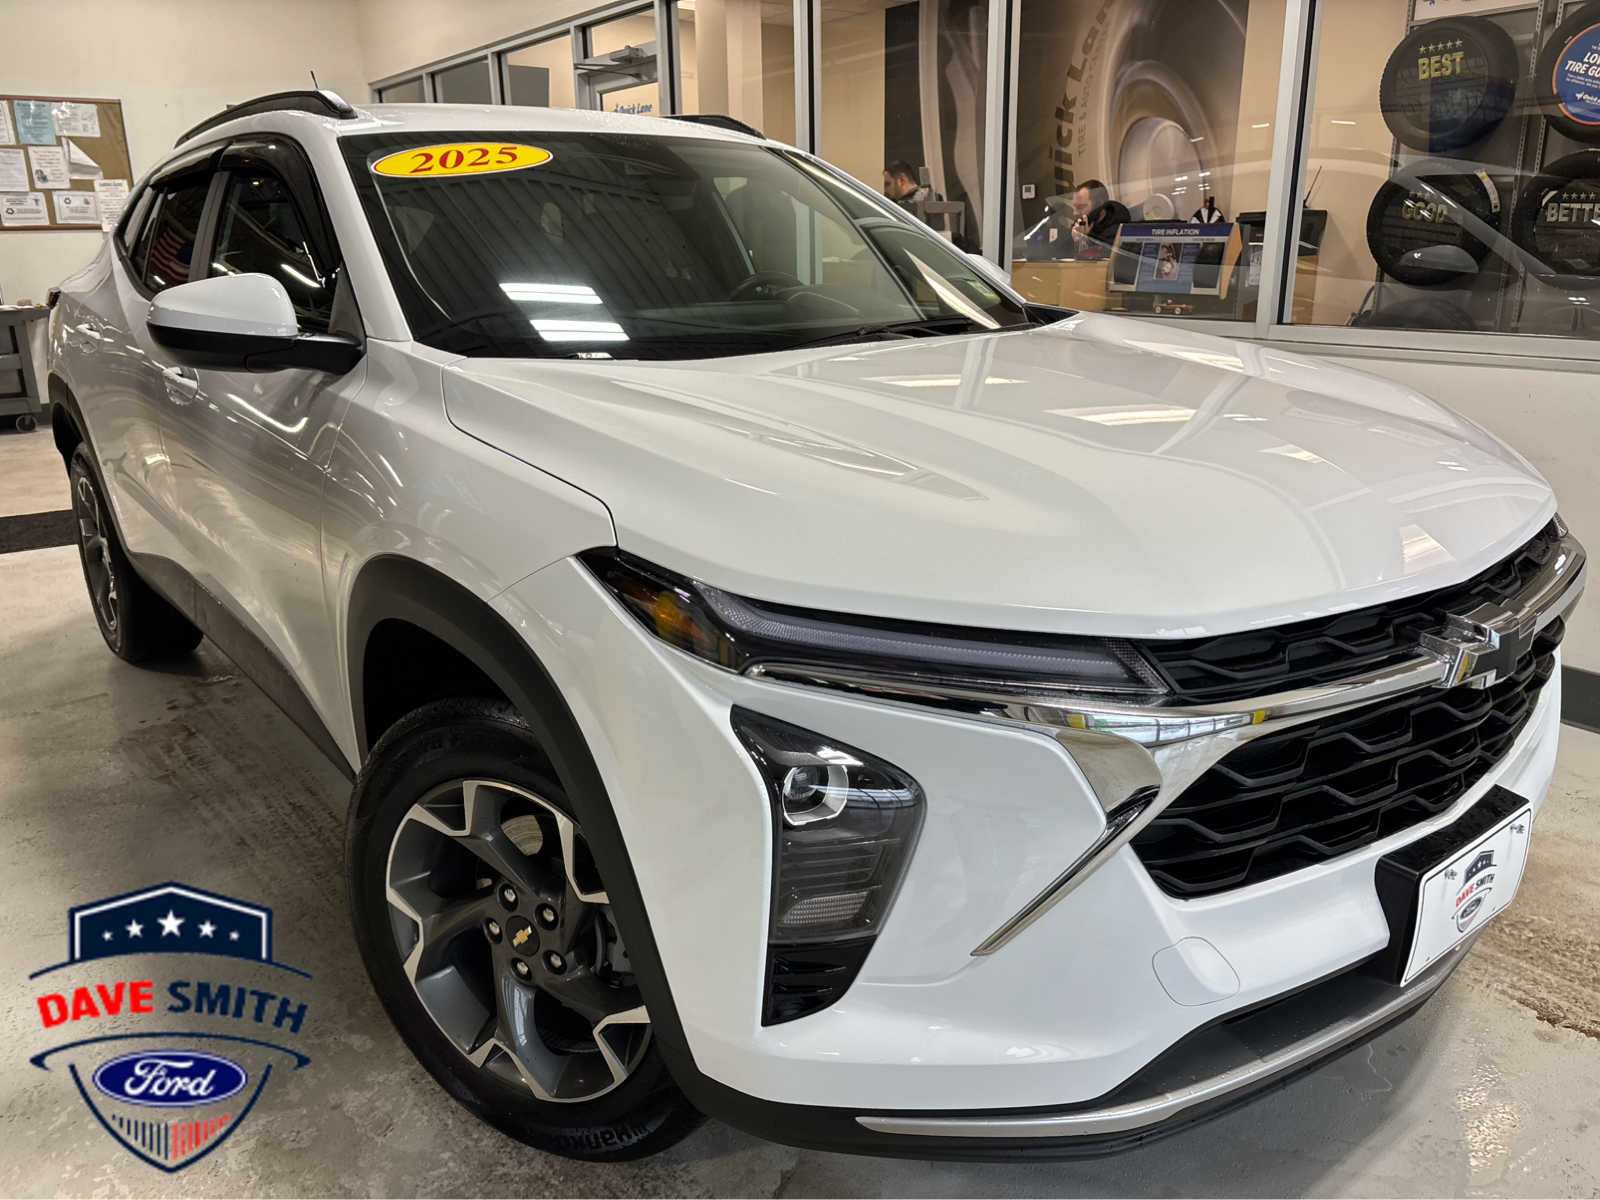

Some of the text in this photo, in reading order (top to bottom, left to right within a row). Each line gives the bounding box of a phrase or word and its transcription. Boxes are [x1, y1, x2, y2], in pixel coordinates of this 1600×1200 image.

[1418, 51, 1464, 80] BEST
[1565, 60, 1589, 75] TIRE
[410, 146, 518, 173] 2025
[1401, 199, 1448, 223] GOOD
[1166, 228, 1200, 236] INFLATION
[1456, 883, 1475, 908] DAVE
[1475, 873, 1495, 889] SMITH
